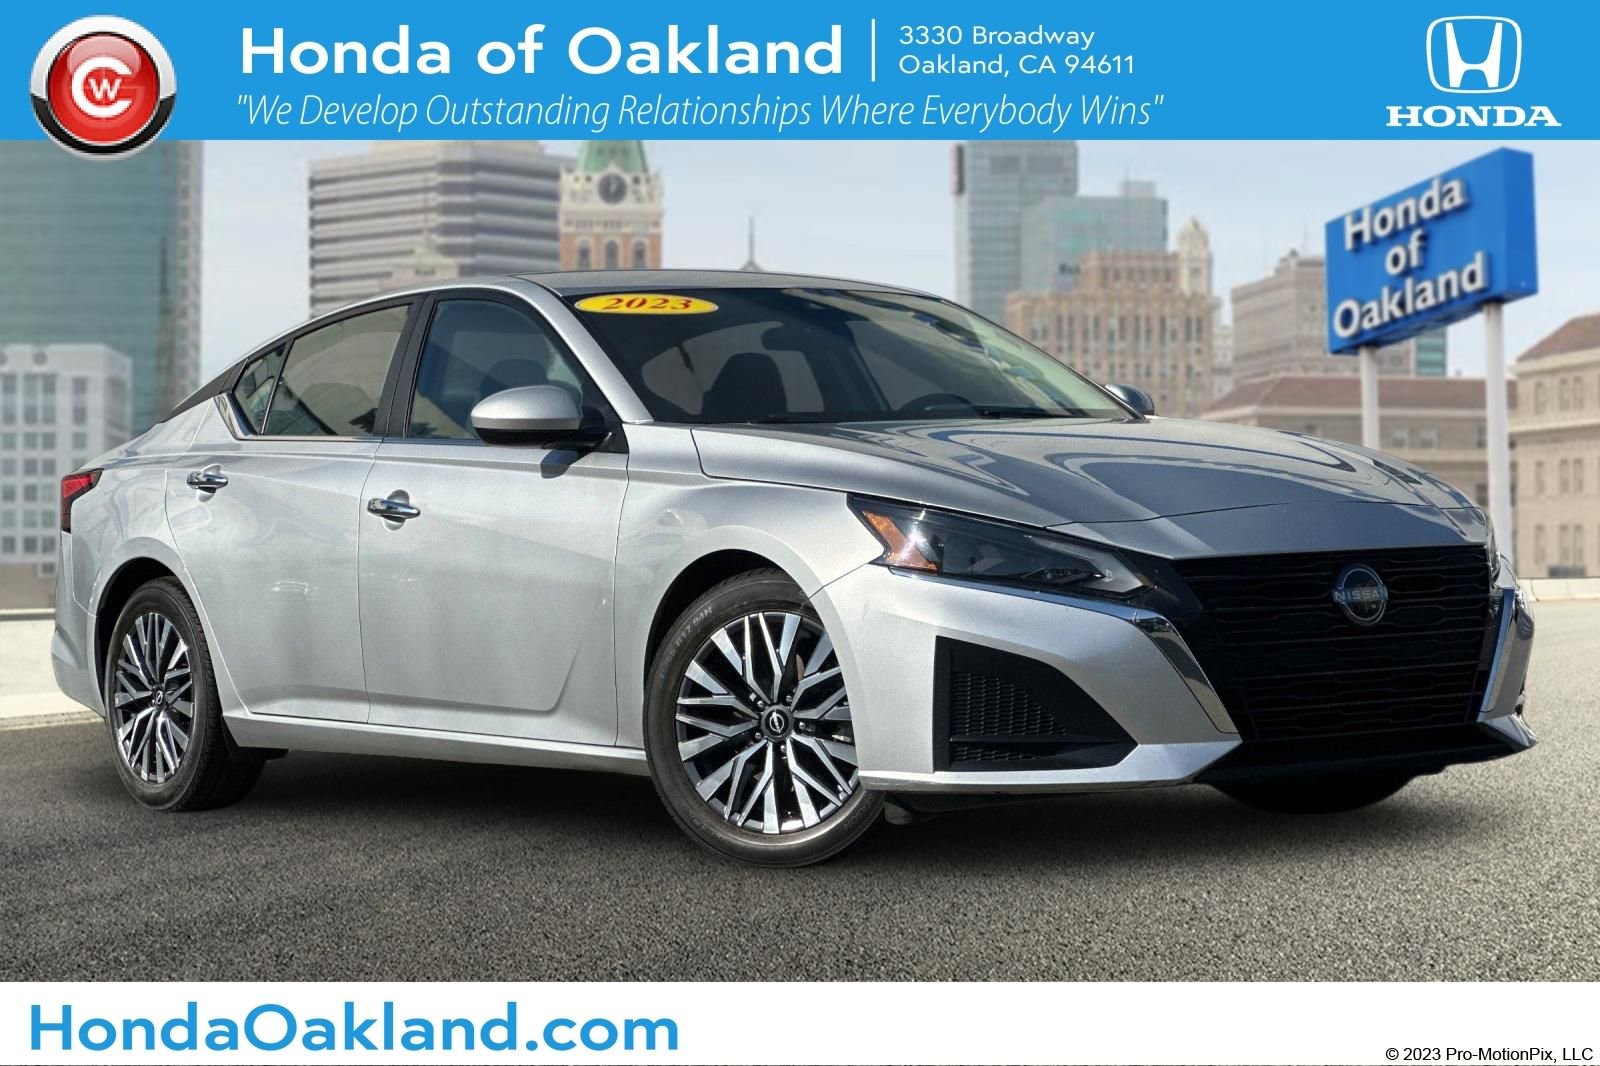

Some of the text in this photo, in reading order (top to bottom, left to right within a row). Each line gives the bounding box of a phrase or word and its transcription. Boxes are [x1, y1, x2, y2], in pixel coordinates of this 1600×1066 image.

[1344, 175, 1467, 251] Honda
[1385, 229, 1424, 275] of
[602, 297, 694, 310] 2023
[1333, 251, 1487, 338] Oakland
[1334, 589, 1387, 601] NISSAN
